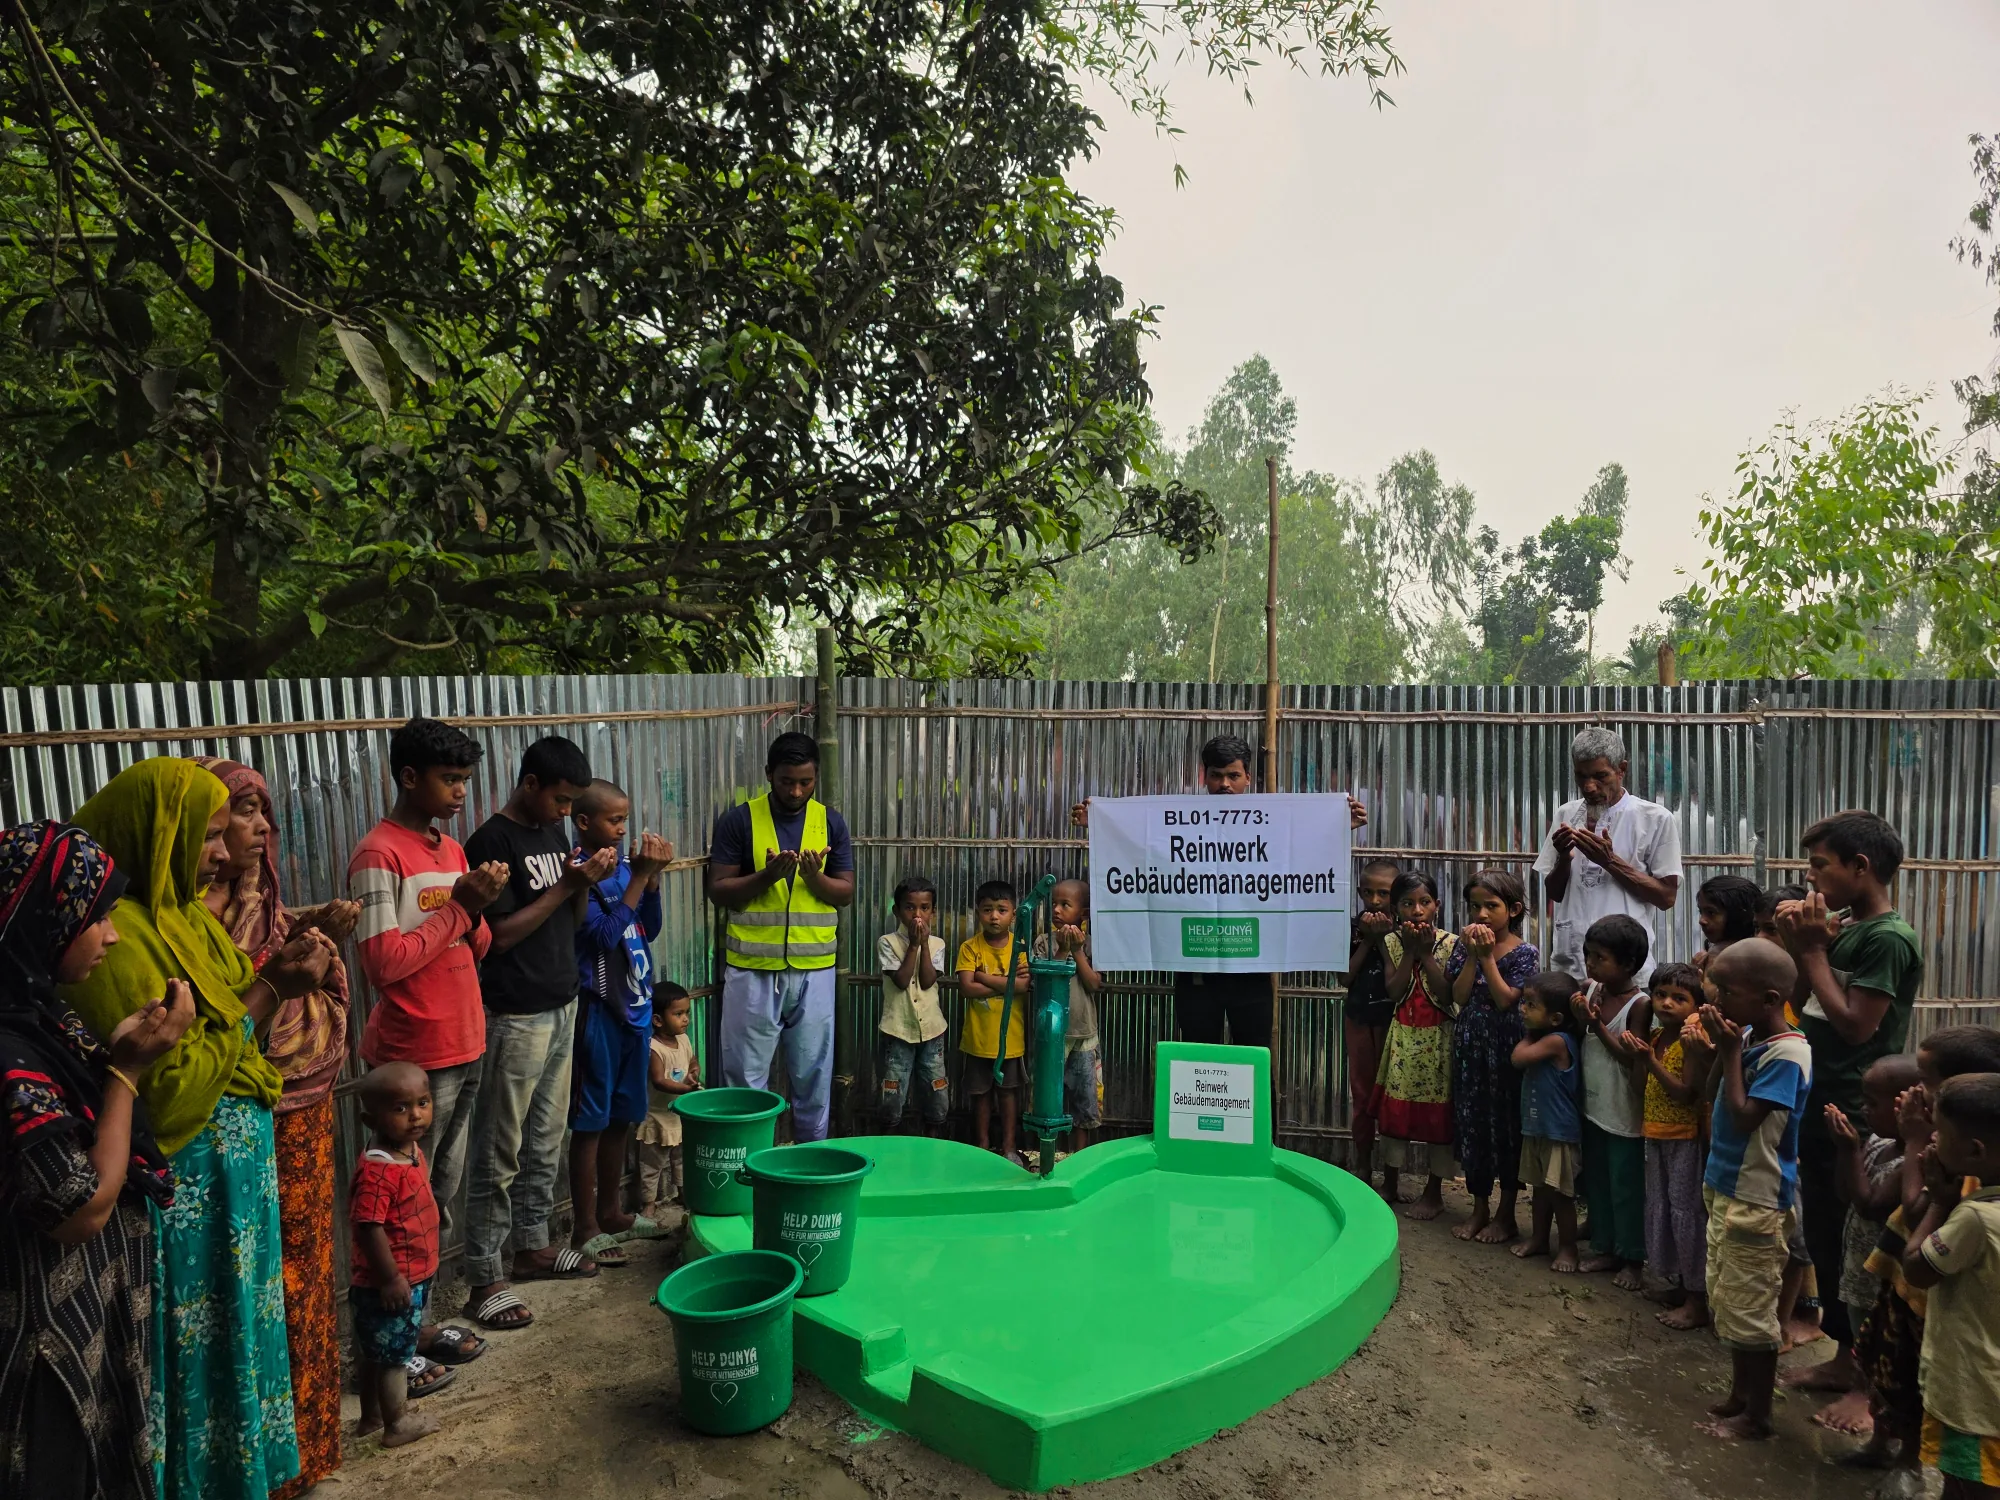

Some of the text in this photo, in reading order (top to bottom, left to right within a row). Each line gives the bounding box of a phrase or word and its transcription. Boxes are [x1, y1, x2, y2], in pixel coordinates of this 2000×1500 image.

[1164, 810, 1269, 826] BL01-7773:
[1170, 835, 1269, 863] Reinwerk
[1106, 866, 1336, 902] Gebäudemanagement
[1188, 925, 1214, 936] HELP
[1189, 946, 1253, 954] www.help-dunya.com
[1194, 1068, 1230, 1077] BL01-7773:
[1195, 1080, 1229, 1094] Reinwerk
[1173, 1092, 1250, 1111] Gebäudemanagement
[696, 1144, 716, 1158] HELP
[783, 1212, 808, 1228] HELP
[691, 1348, 716, 1367] HELP
[718, 1363, 759, 1379] MITMENSCHEN
